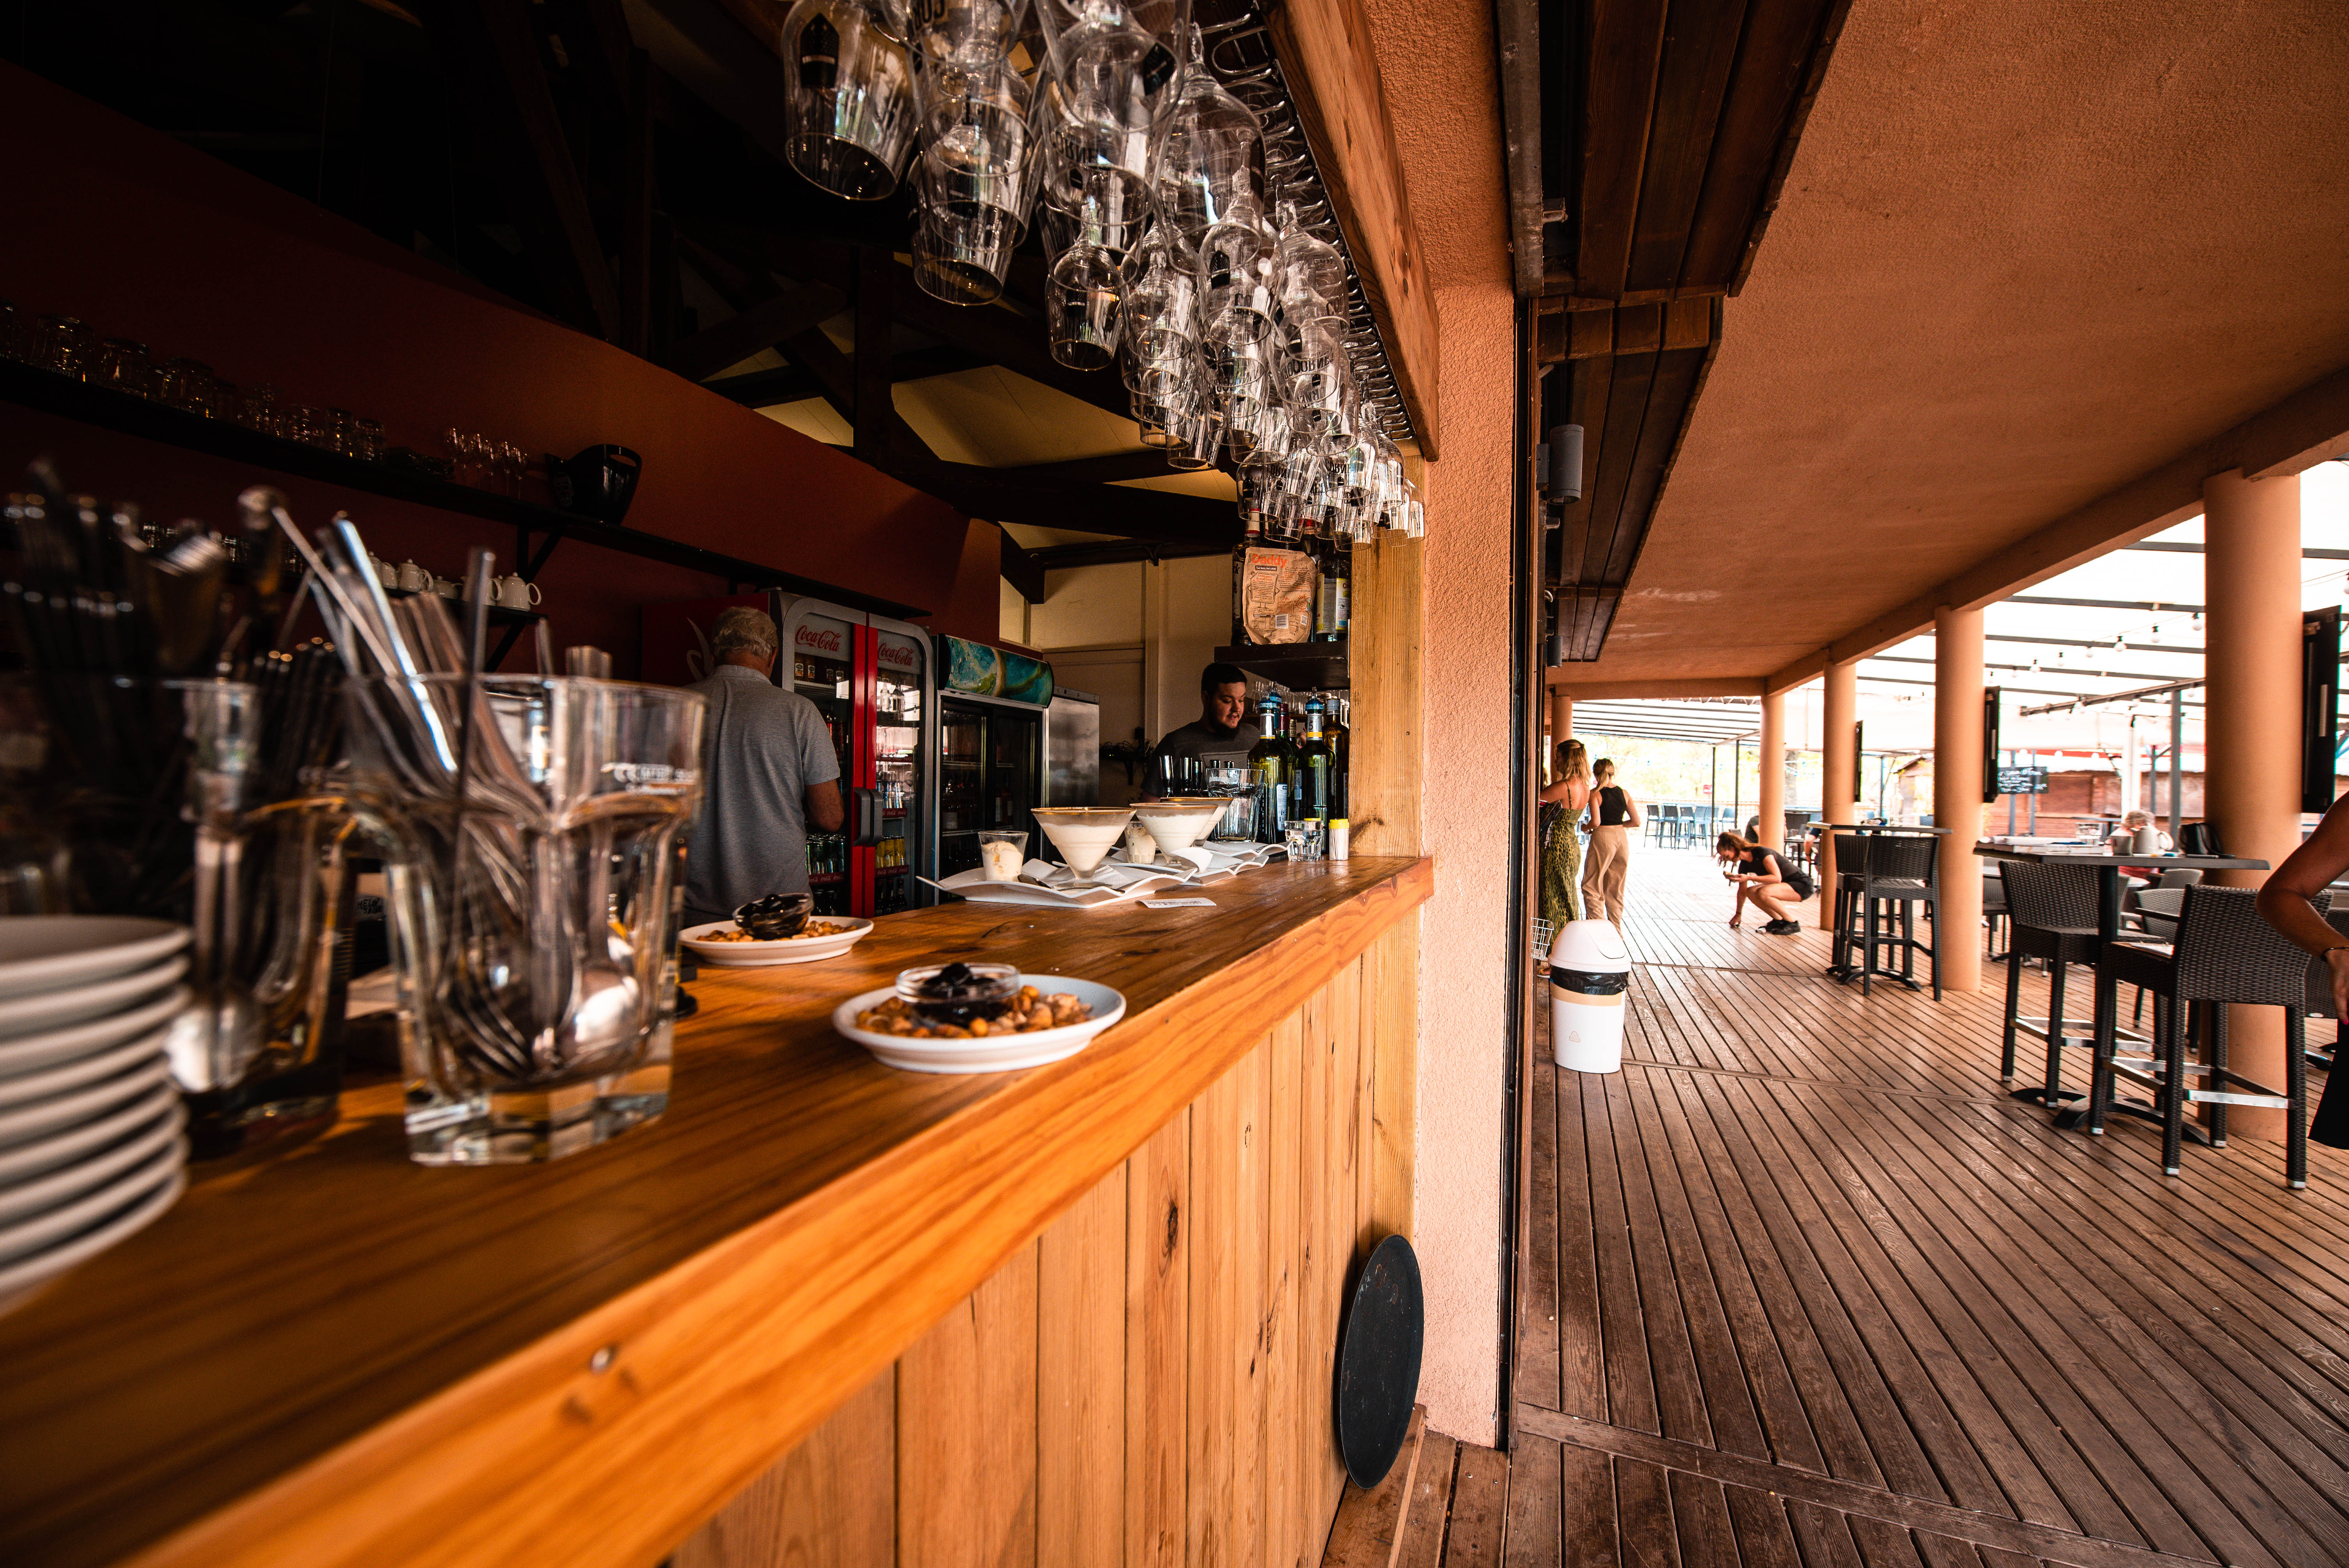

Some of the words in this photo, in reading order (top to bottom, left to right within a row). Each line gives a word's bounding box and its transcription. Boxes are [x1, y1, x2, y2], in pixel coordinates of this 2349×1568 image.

[1252, 554, 1287, 568] Daddy
[795, 625, 841, 652] Coca-Cola
[879, 643, 914, 666] Coca-Cola
